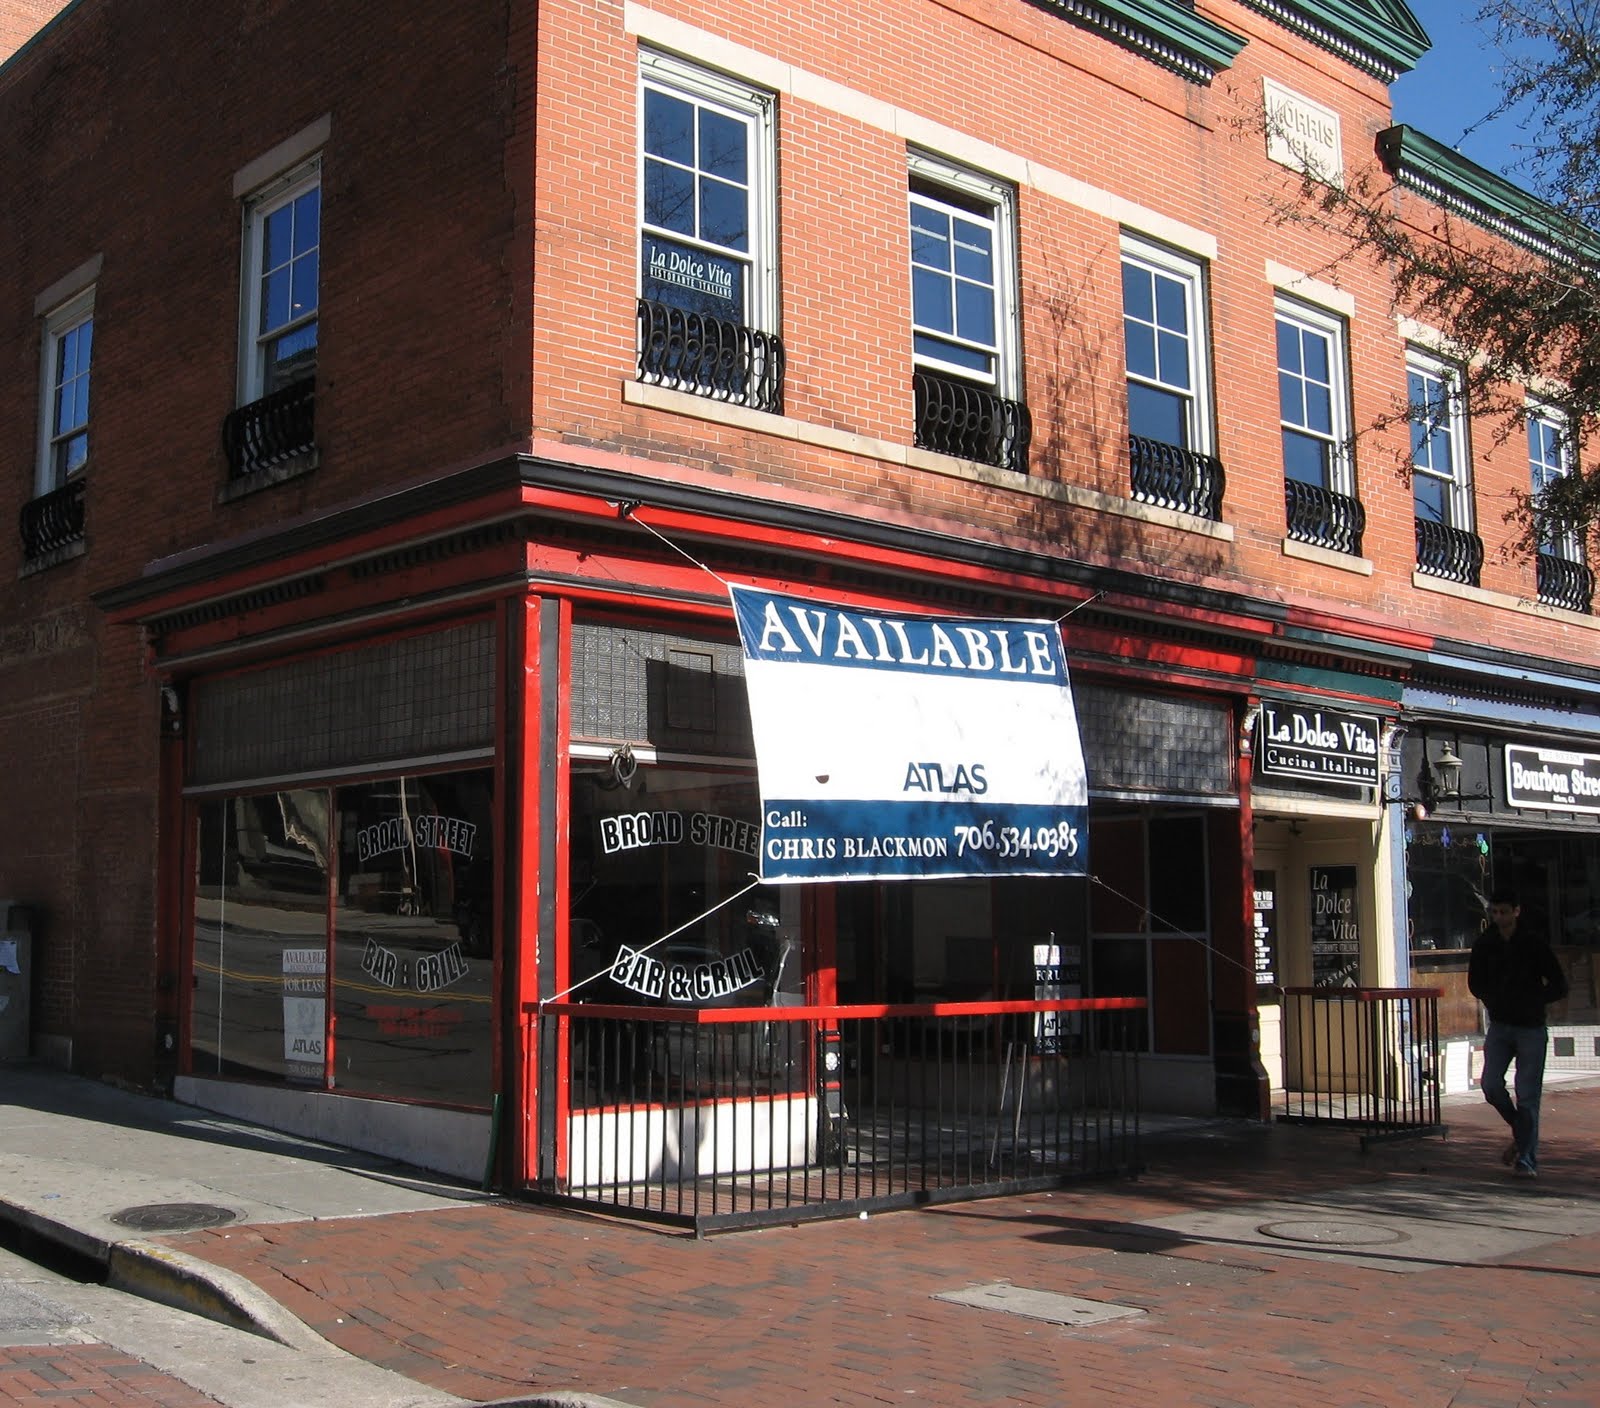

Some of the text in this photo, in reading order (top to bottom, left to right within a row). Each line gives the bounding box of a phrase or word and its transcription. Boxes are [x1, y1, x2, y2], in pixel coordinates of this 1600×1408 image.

[650, 246, 732, 286] La Dolce Vita
[650, 267, 733, 298] RISTORANTE ITALIANO
[759, 601, 1056, 676] AVAILABLE
[1267, 710, 1376, 754] La Dolce Vita
[903, 762, 988, 795] ATLAS
[1268, 750, 1376, 776] Cucina Italiana
[1512, 762, 1600, 797] Bourbon Stre
[600, 811, 760, 858] BROAD STREE
[767, 811, 807, 828] Call:
[358, 815, 476, 862] BROAD STREET
[767, 819, 1078, 860] CHRIS BLACKMON 706.534.0385
[1313, 870, 1328, 890] La
[1316, 892, 1351, 914] Dolce
[1332, 919, 1358, 940] Vita
[361, 938, 397, 988] BAR
[416, 943, 469, 992] GRILL
[610, 944, 765, 1001] BAR & GRILL
[293, 1039, 321, 1055] ATLAS
